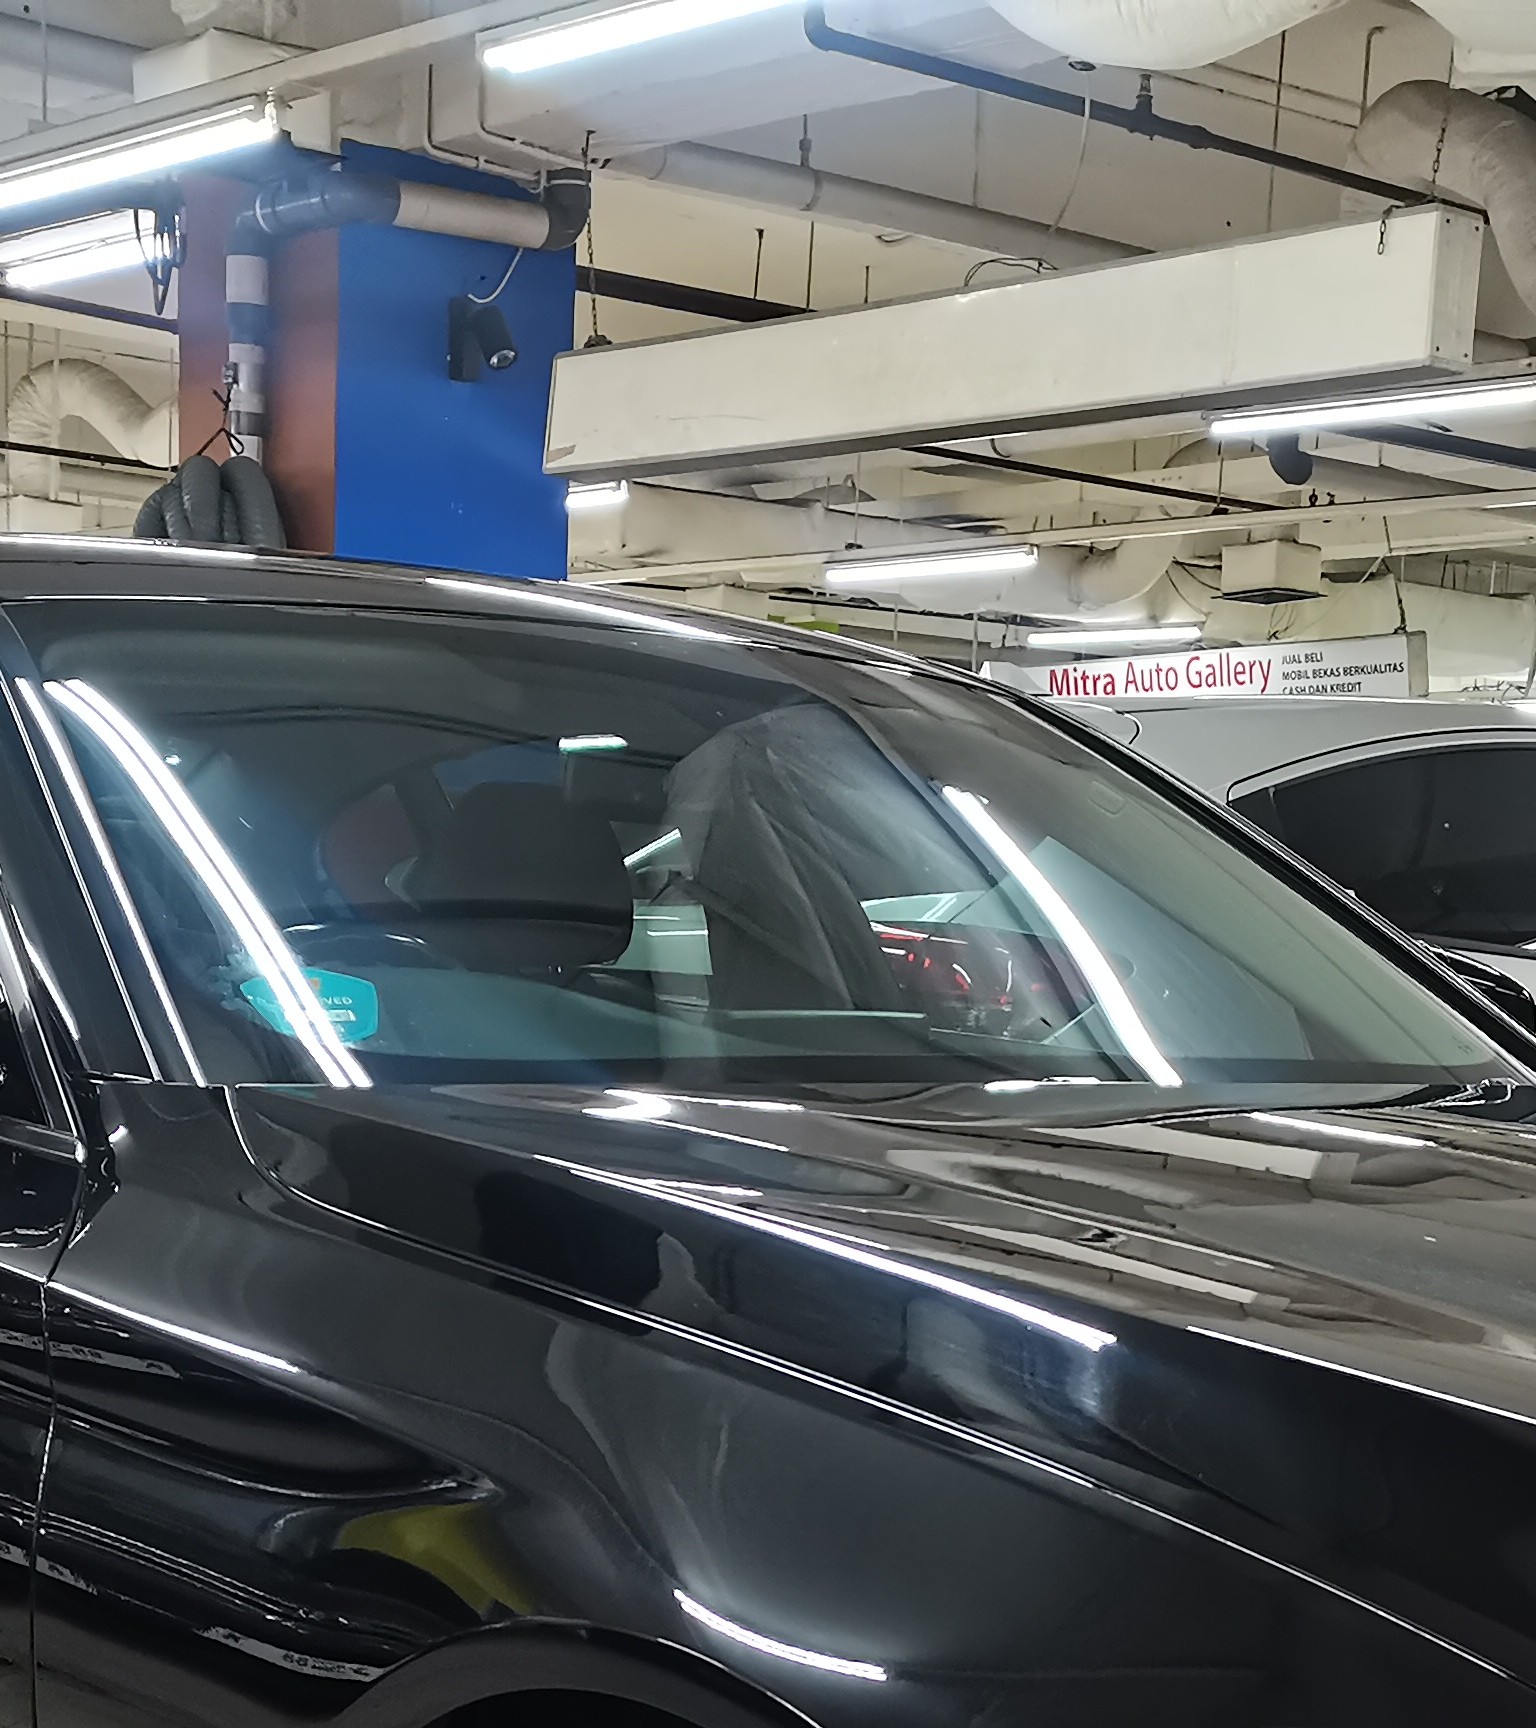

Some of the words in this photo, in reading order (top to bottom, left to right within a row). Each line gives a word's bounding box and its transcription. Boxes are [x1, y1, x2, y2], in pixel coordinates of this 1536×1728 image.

[1282, 654, 1302, 665] JUAL
[1304, 651, 1324, 664] BELI
[1049, 666, 1115, 696] Mitra
[1124, 660, 1179, 693] Auto
[1186, 652, 1272, 694] Gallery
[1282, 669, 1310, 681] MOBIL
[1312, 667, 1341, 679] BEKAS
[1342, 662, 1404, 677] BERKUALITAS
[1308, 684, 1328, 695] DAN
[1329, 681, 1363, 693] KREDIT
